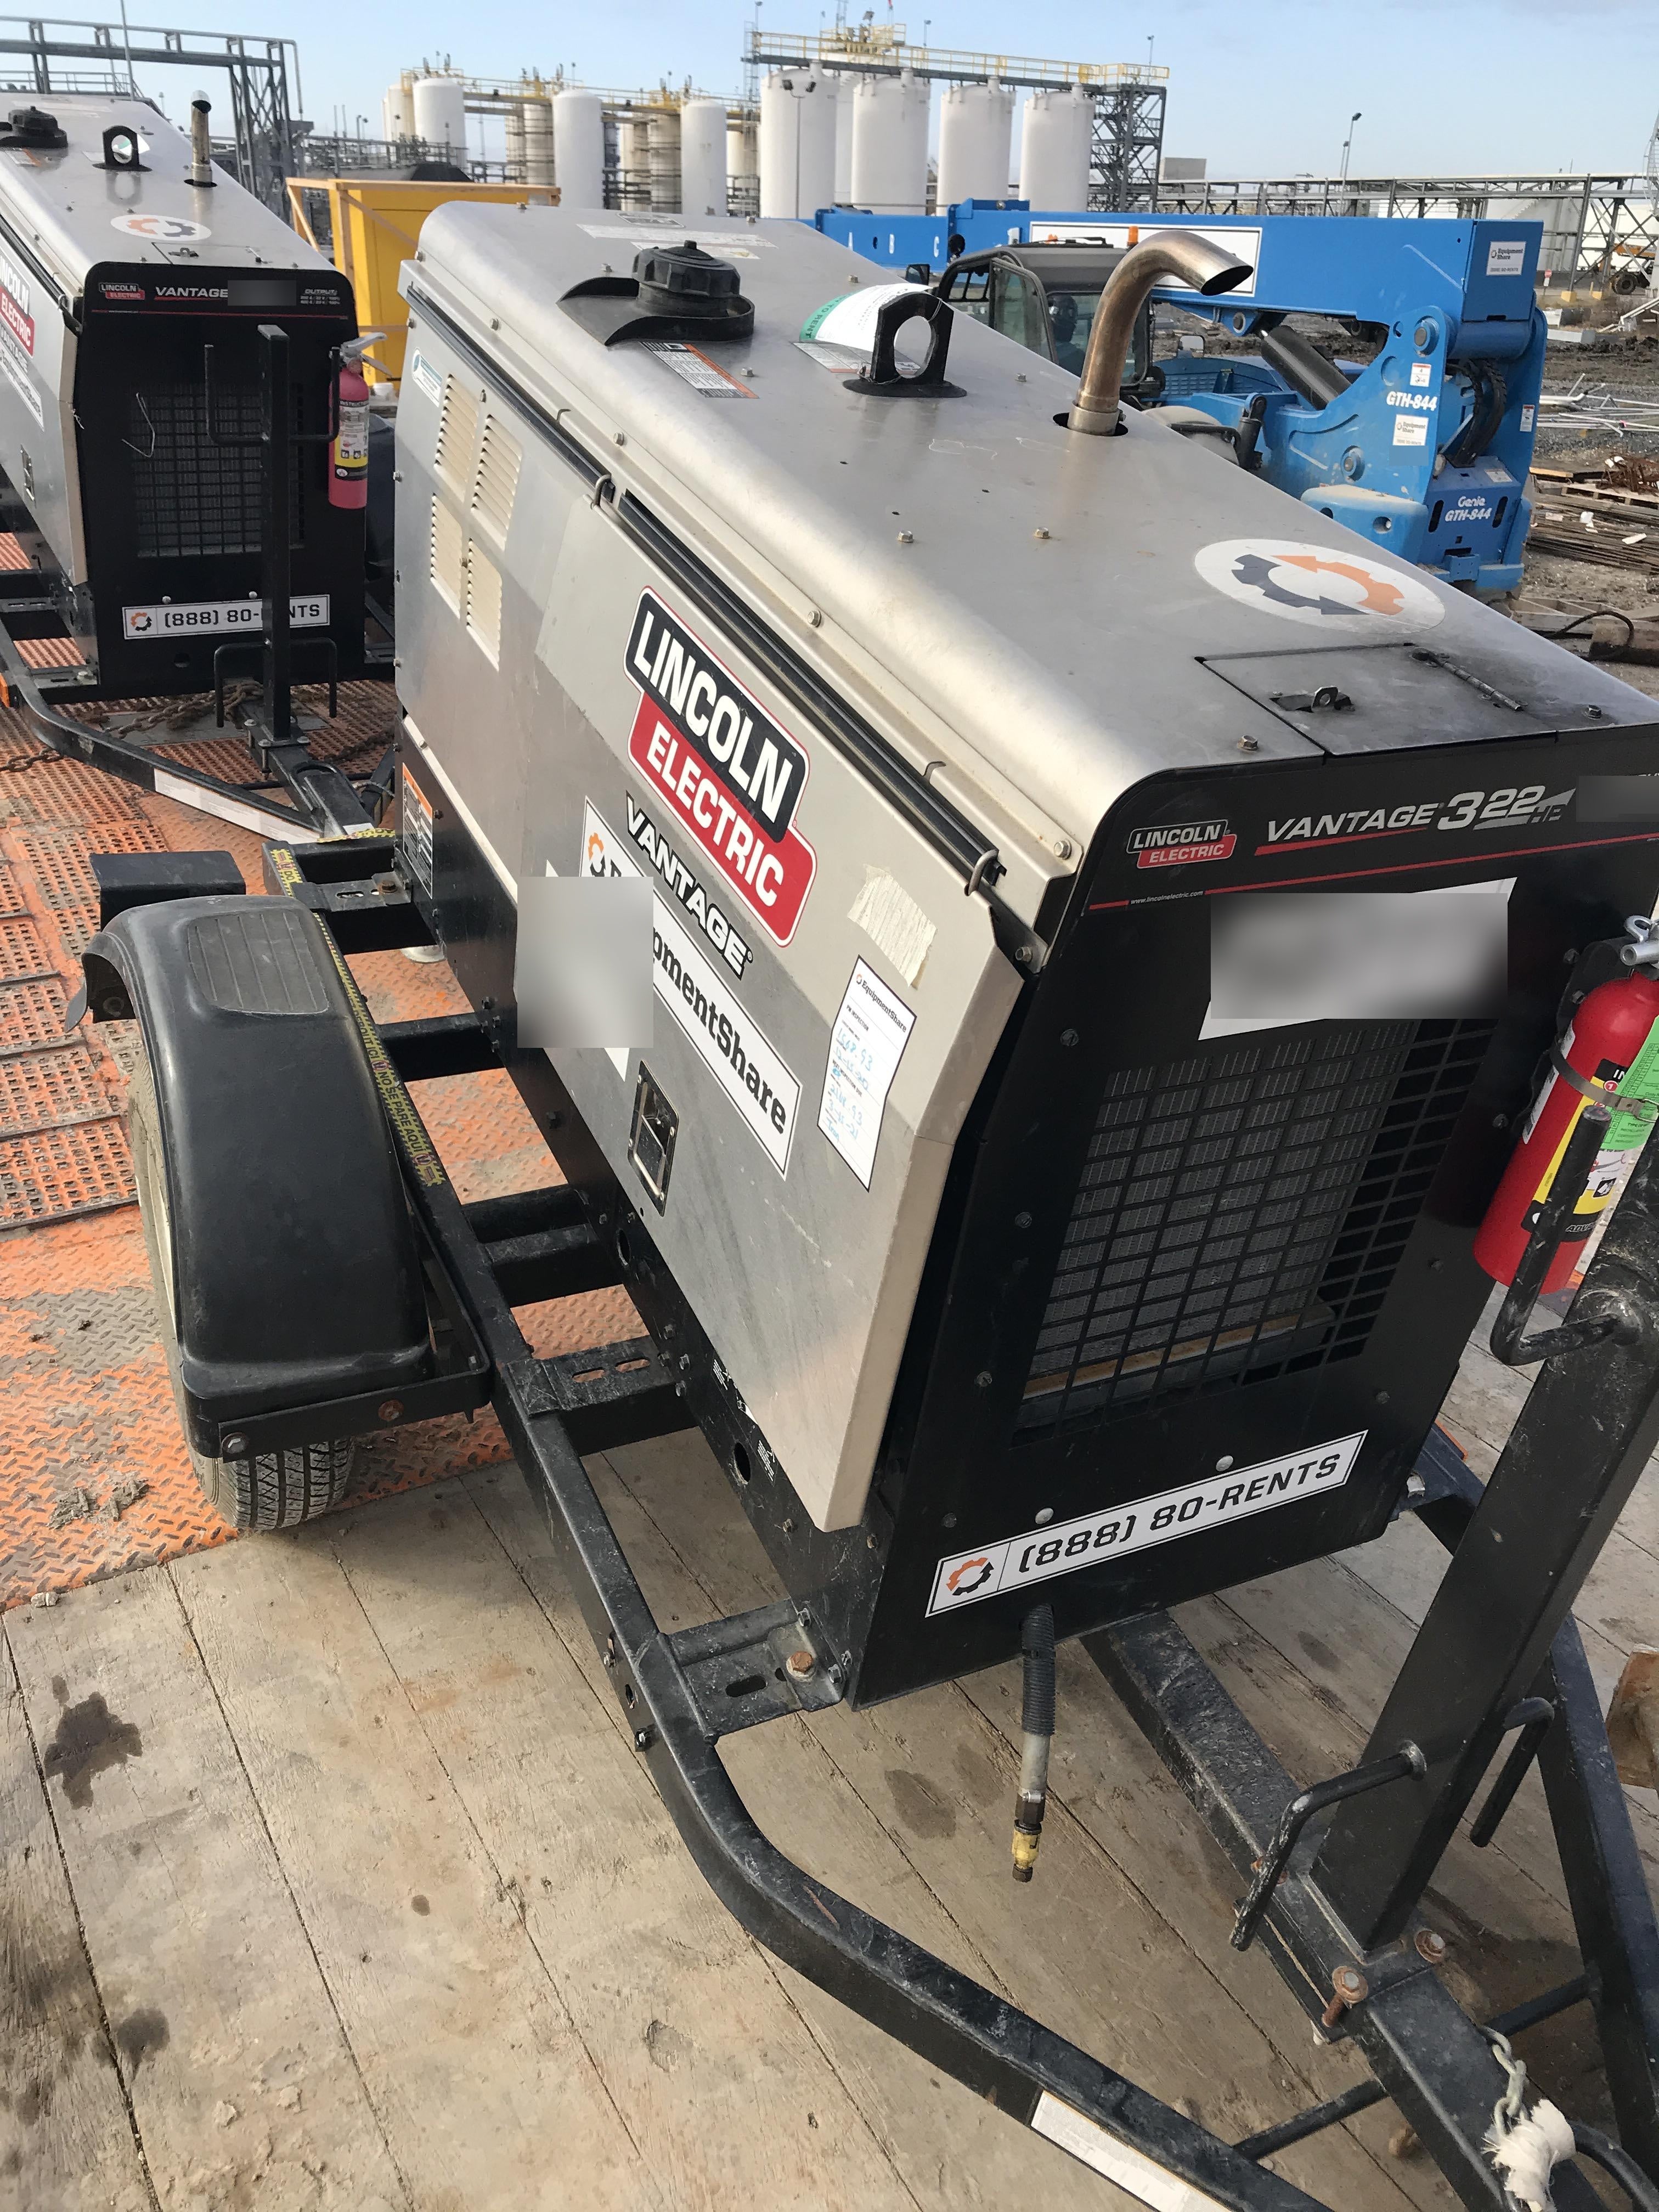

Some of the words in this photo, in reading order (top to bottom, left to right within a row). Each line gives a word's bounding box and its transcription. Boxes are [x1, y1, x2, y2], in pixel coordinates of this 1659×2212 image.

[0, 256, 29, 315] INCOLN
[155, 286, 228, 298] VANTAGE
[1, 292, 31, 347] ELECTRIC
[805, 314, 823, 338] RENT
[1386, 391, 1438, 411] GTH-844
[1458, 496, 1486, 507] Genie
[1444, 507, 1493, 522] GTH-844
[165, 611, 219, 628] (888)
[227, 604, 320, 623] 80-NTS
[634, 610, 794, 823] LINCOLN
[646, 720, 785, 907] ELECTRIC
[1267, 802, 1440, 843] VANTAGE
[1437, 785, 1546, 831] 322
[1133, 824, 1221, 849] LINCOLN
[1149, 843, 1225, 864] ELECTRIC
[284, 871, 295, 881] DO
[627, 791, 746, 979] VANTAGE
[1131, 890, 1204, 905] www.lincolnelectric.com
[861, 980, 907, 1033] EquipmentShare
[851, 1010, 870, 1032] INSPECTION
[366, 1047, 380, 1059] ICI
[377, 1071, 392, 1086] NO
[385, 1087, 399, 1099] SE
[391, 1101, 411, 1127] PARE
[1018, 1514, 1136, 1573] (888)
[1149, 1453, 1341, 1531] 80-RENTS
